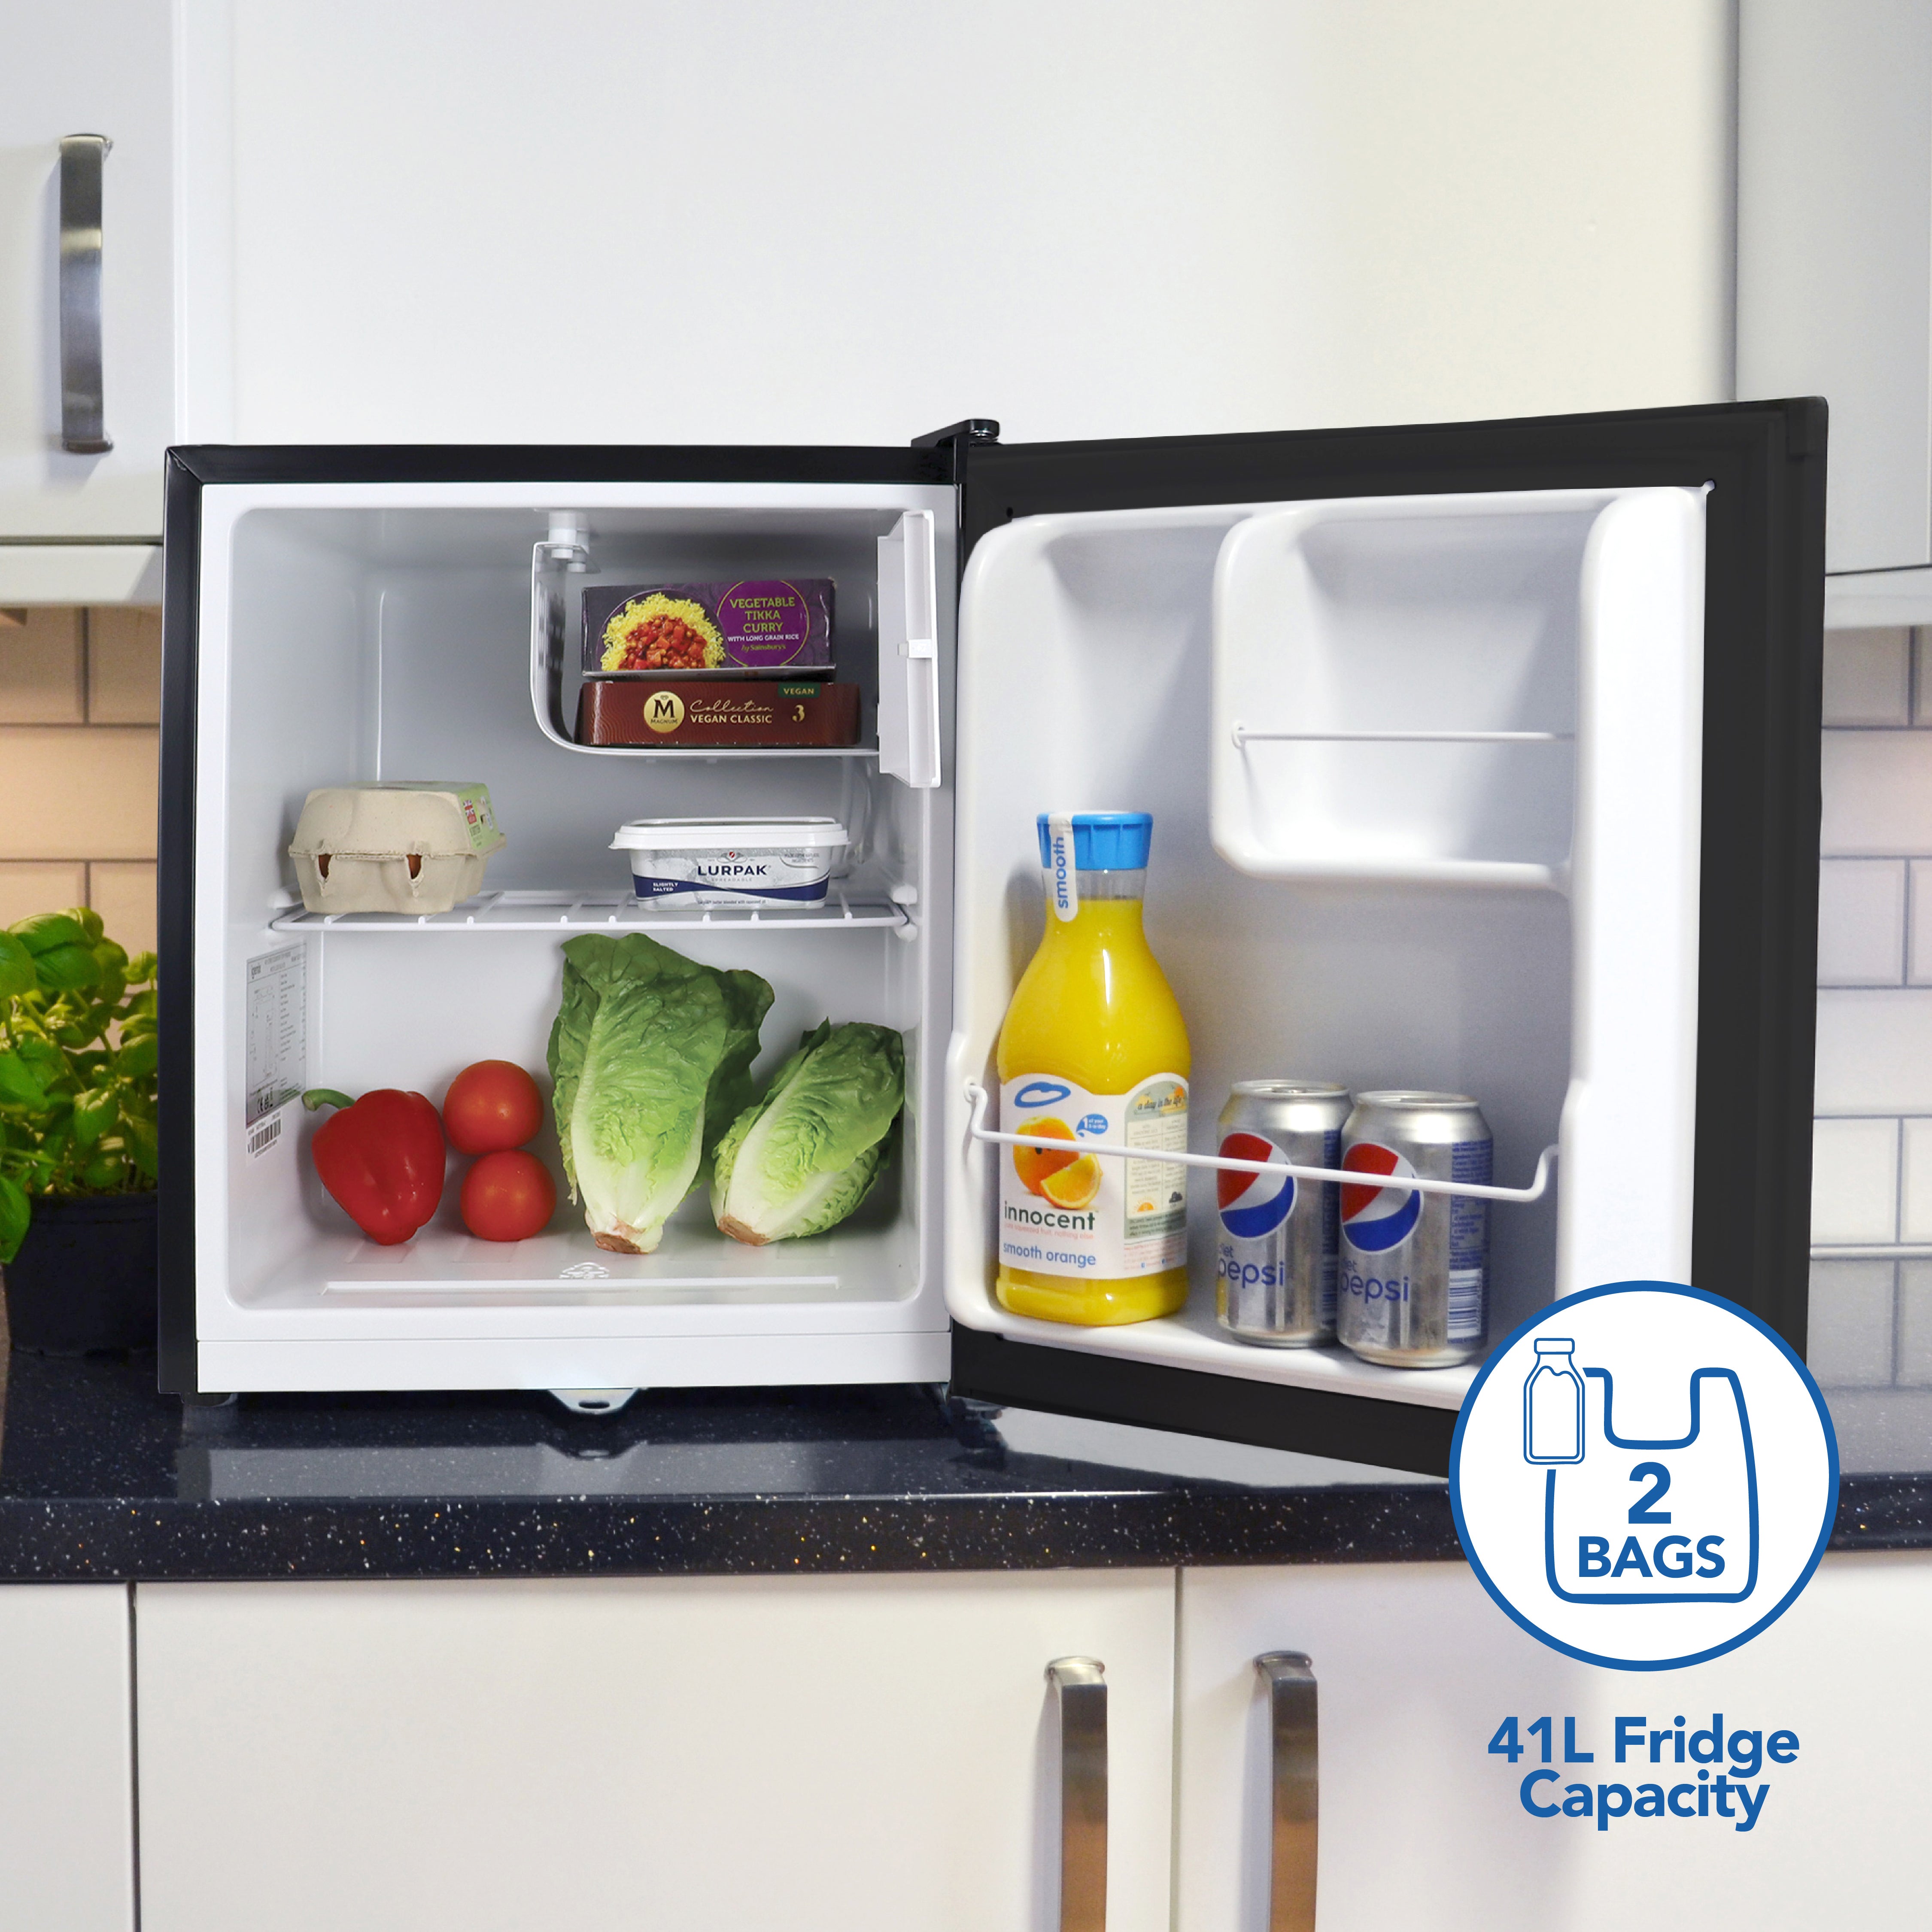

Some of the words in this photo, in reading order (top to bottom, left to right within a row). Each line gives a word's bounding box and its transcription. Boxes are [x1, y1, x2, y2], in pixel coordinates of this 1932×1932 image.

[730, 597, 796, 608] VEGETABLE
[744, 610, 781, 620] TIKKA
[743, 622, 783, 633] CURRY
[690, 699, 774, 713] Collection
[690, 714, 727, 724] VEGAN
[730, 714, 772, 724] CLASSIC
[792, 704, 805, 723] 3
[698, 865, 768, 875] LURPAK
[1053, 837, 1069, 909] smooth
[1084, 1118, 1088, 1129] 1
[1004, 1200, 1095, 1230] innocent
[1003, 1243, 1042, 1259] smooth
[1046, 1251, 1096, 1268] orange
